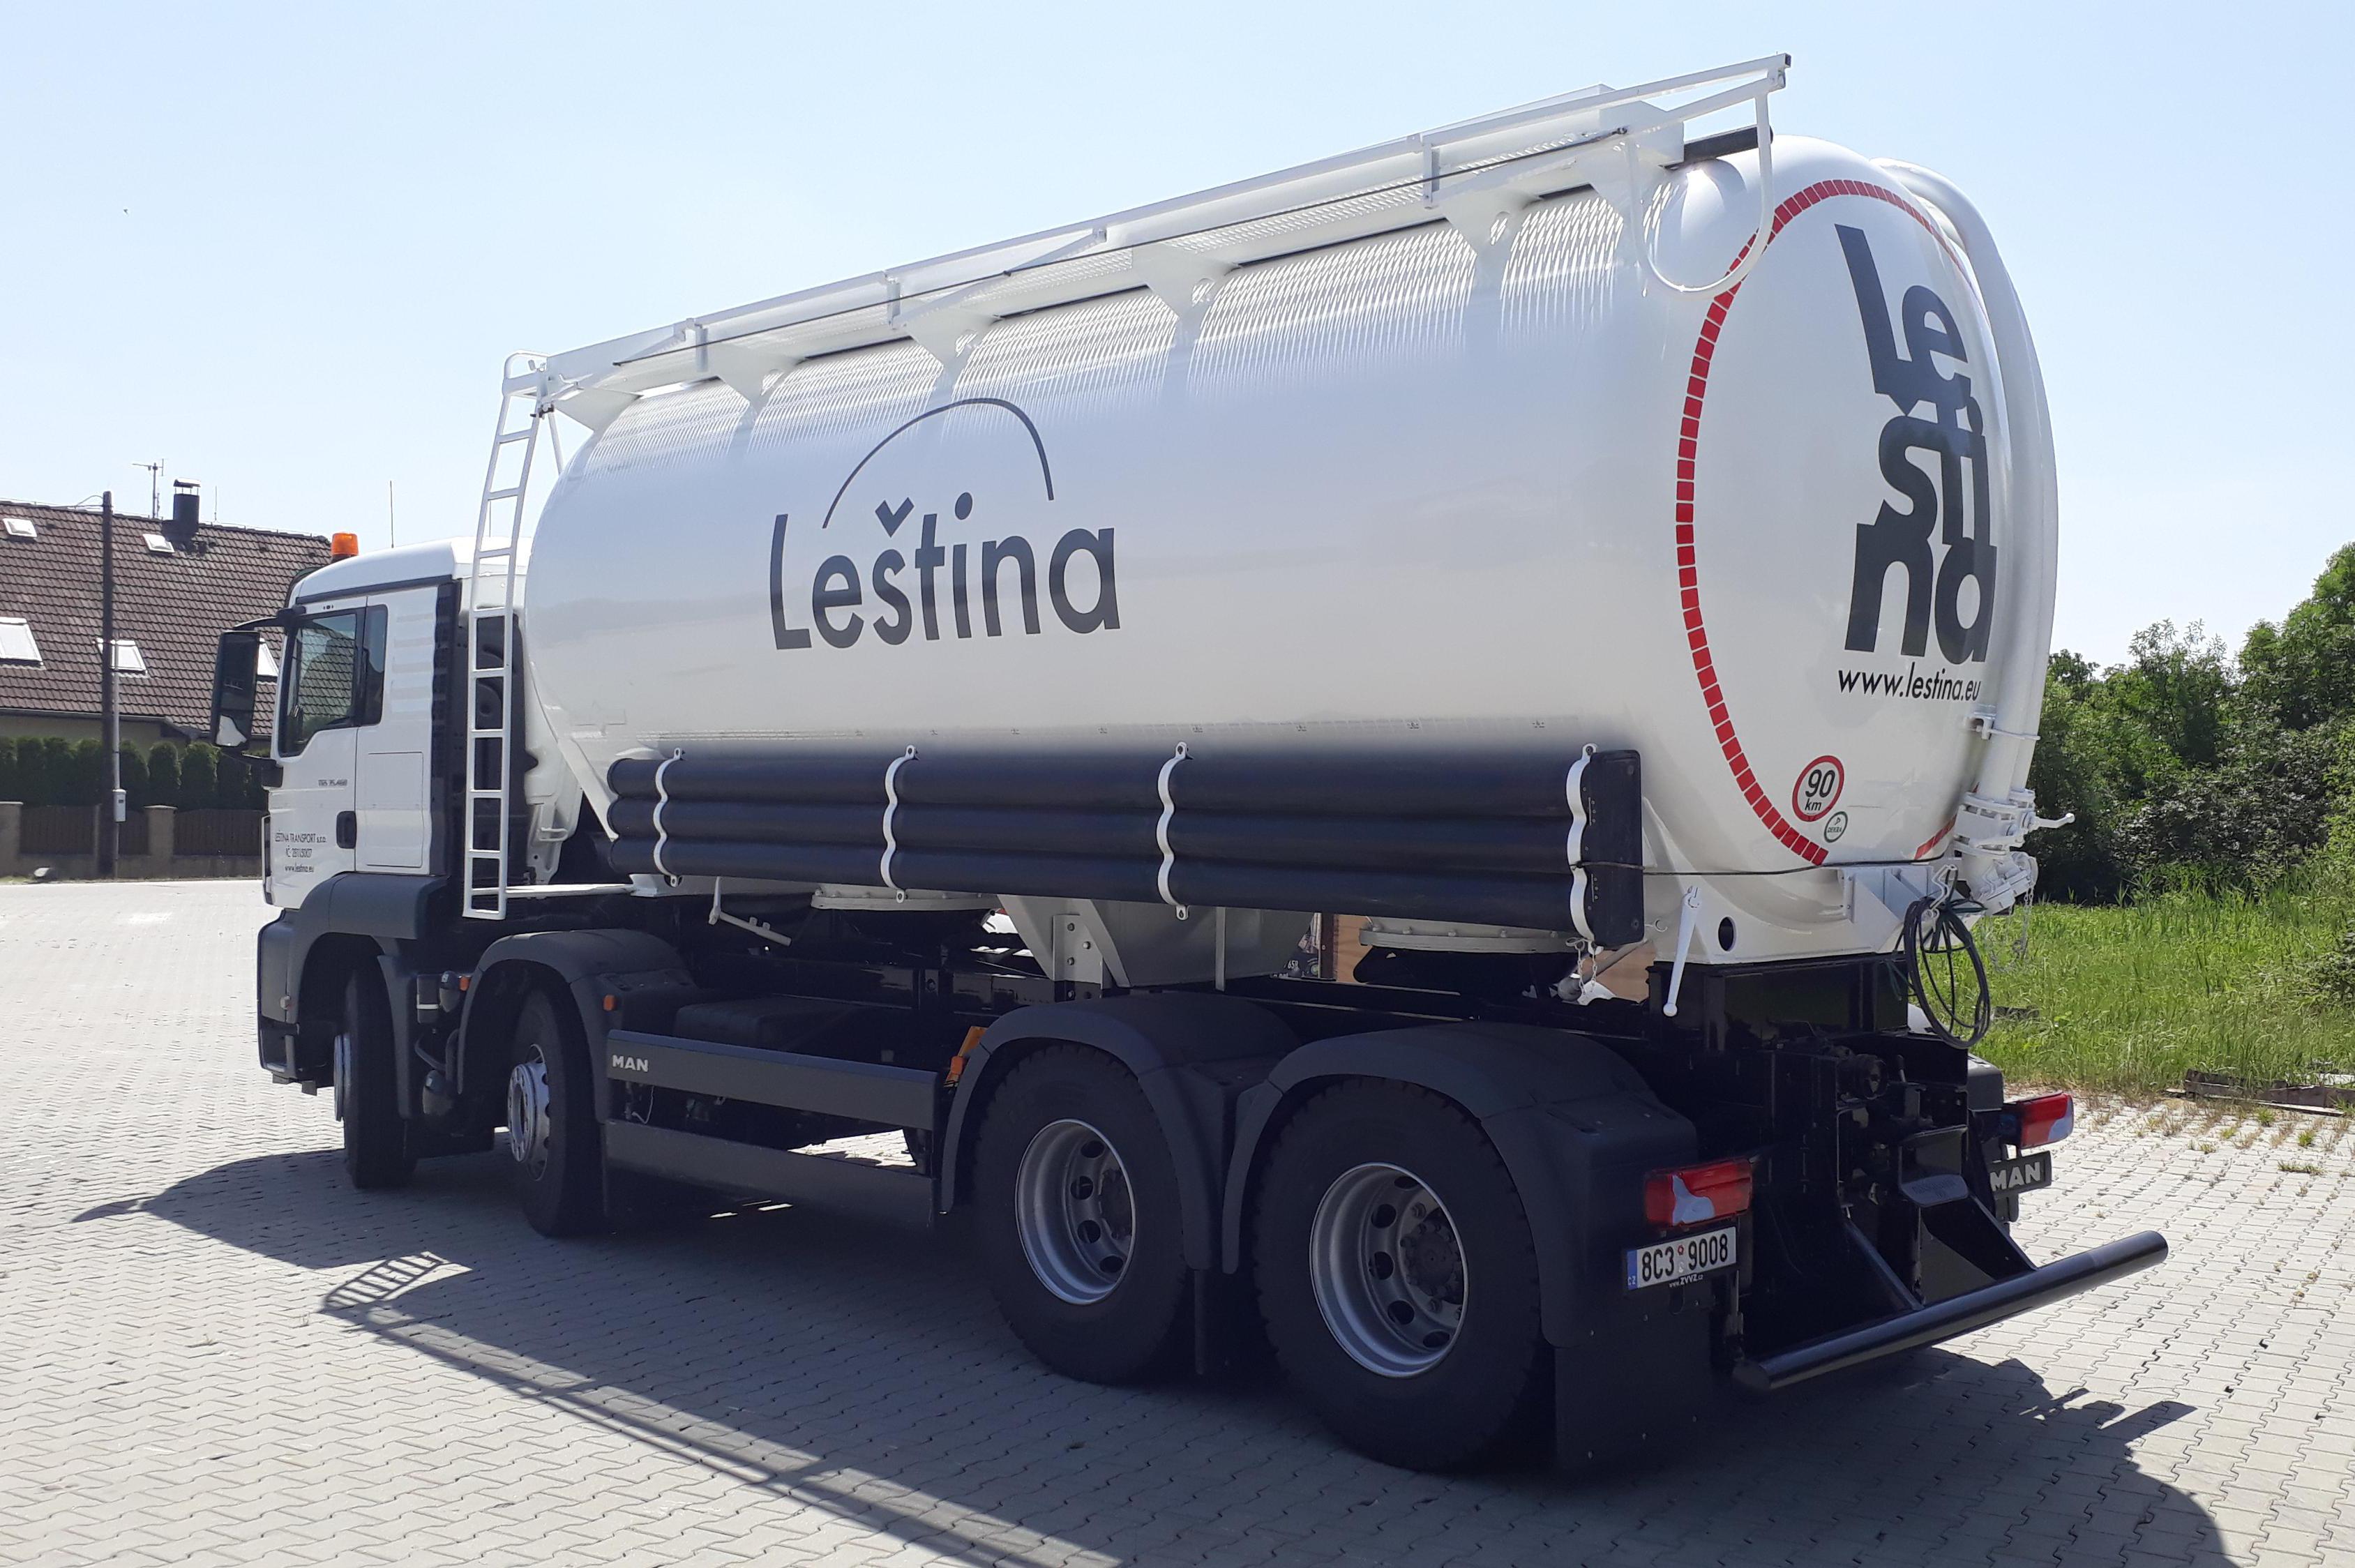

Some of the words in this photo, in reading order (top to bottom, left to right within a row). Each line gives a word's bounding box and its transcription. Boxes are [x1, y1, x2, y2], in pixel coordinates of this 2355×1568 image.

[769, 492, 1121, 650] Leština
[1837, 661, 1982, 702] www.lestina.eu
[1805, 769, 1836, 798] 90
[1804, 797, 1823, 811] km
[289, 833, 316, 843] TRANSPORT
[612, 1054, 649, 1073] MAN
[1989, 1161, 2041, 1192] MAN
[1627, 1275, 1637, 1286] CZ
[1641, 1246, 1675, 1282] 8C3
[1688, 1233, 1729, 1271] 9008
